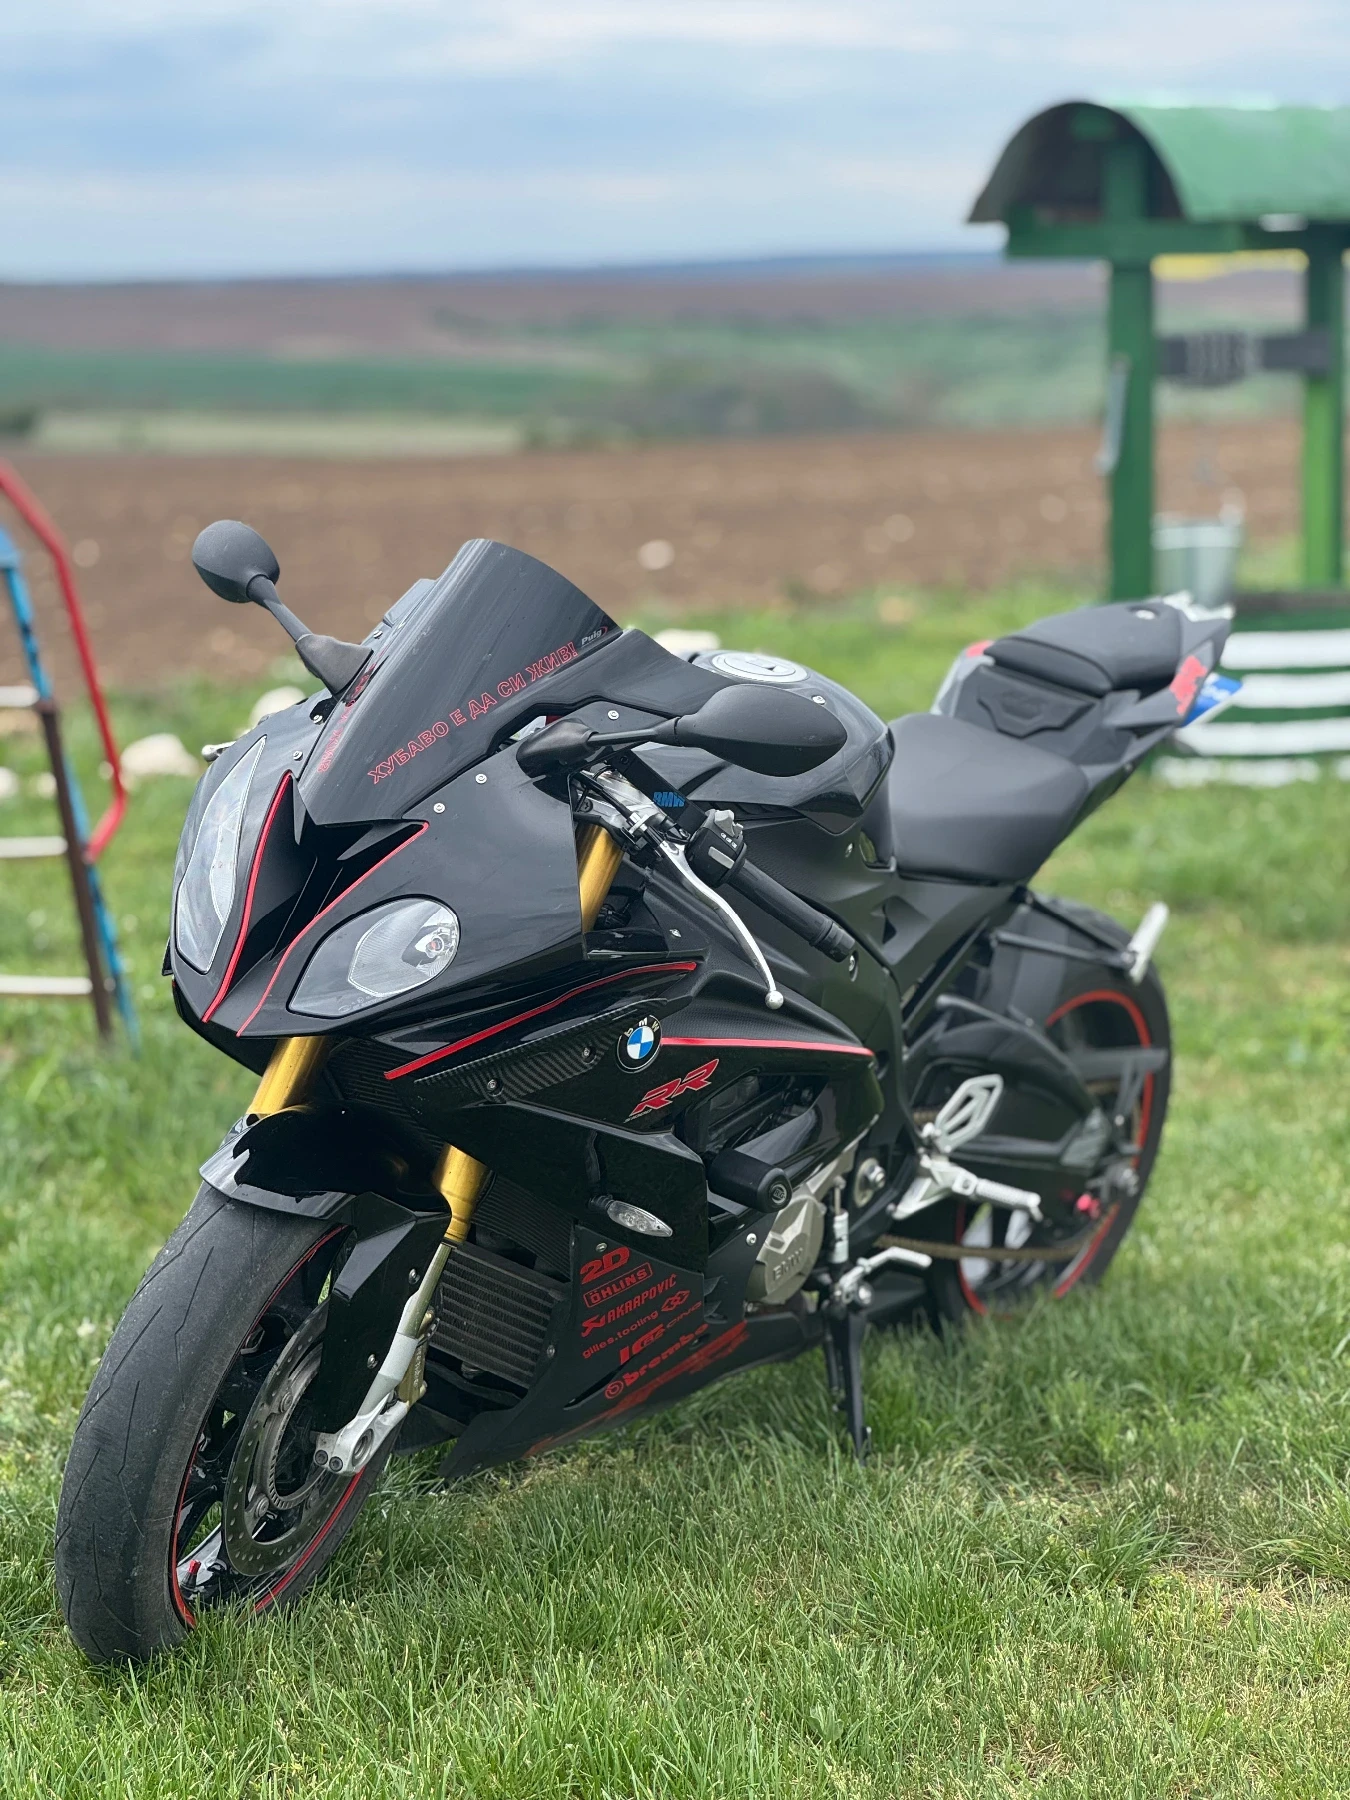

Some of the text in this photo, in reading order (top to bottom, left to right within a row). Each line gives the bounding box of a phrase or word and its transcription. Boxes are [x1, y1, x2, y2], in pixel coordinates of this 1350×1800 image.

[581, 629, 602, 646] Puig
[367, 721, 449, 785] ХУБАВО
[449, 708, 467, 727] Е
[467, 692, 498, 720] ДА
[497, 672, 527, 698] СИ
[525, 641, 579, 682] ЖИВ!
[629, 1058, 719, 1117] RR
[580, 1246, 630, 1285] 2D
[590, 1268, 648, 1304] ÖHLINS
[582, 1311, 659, 1359] gilles.tooling
[622, 1323, 709, 1387] brembo
